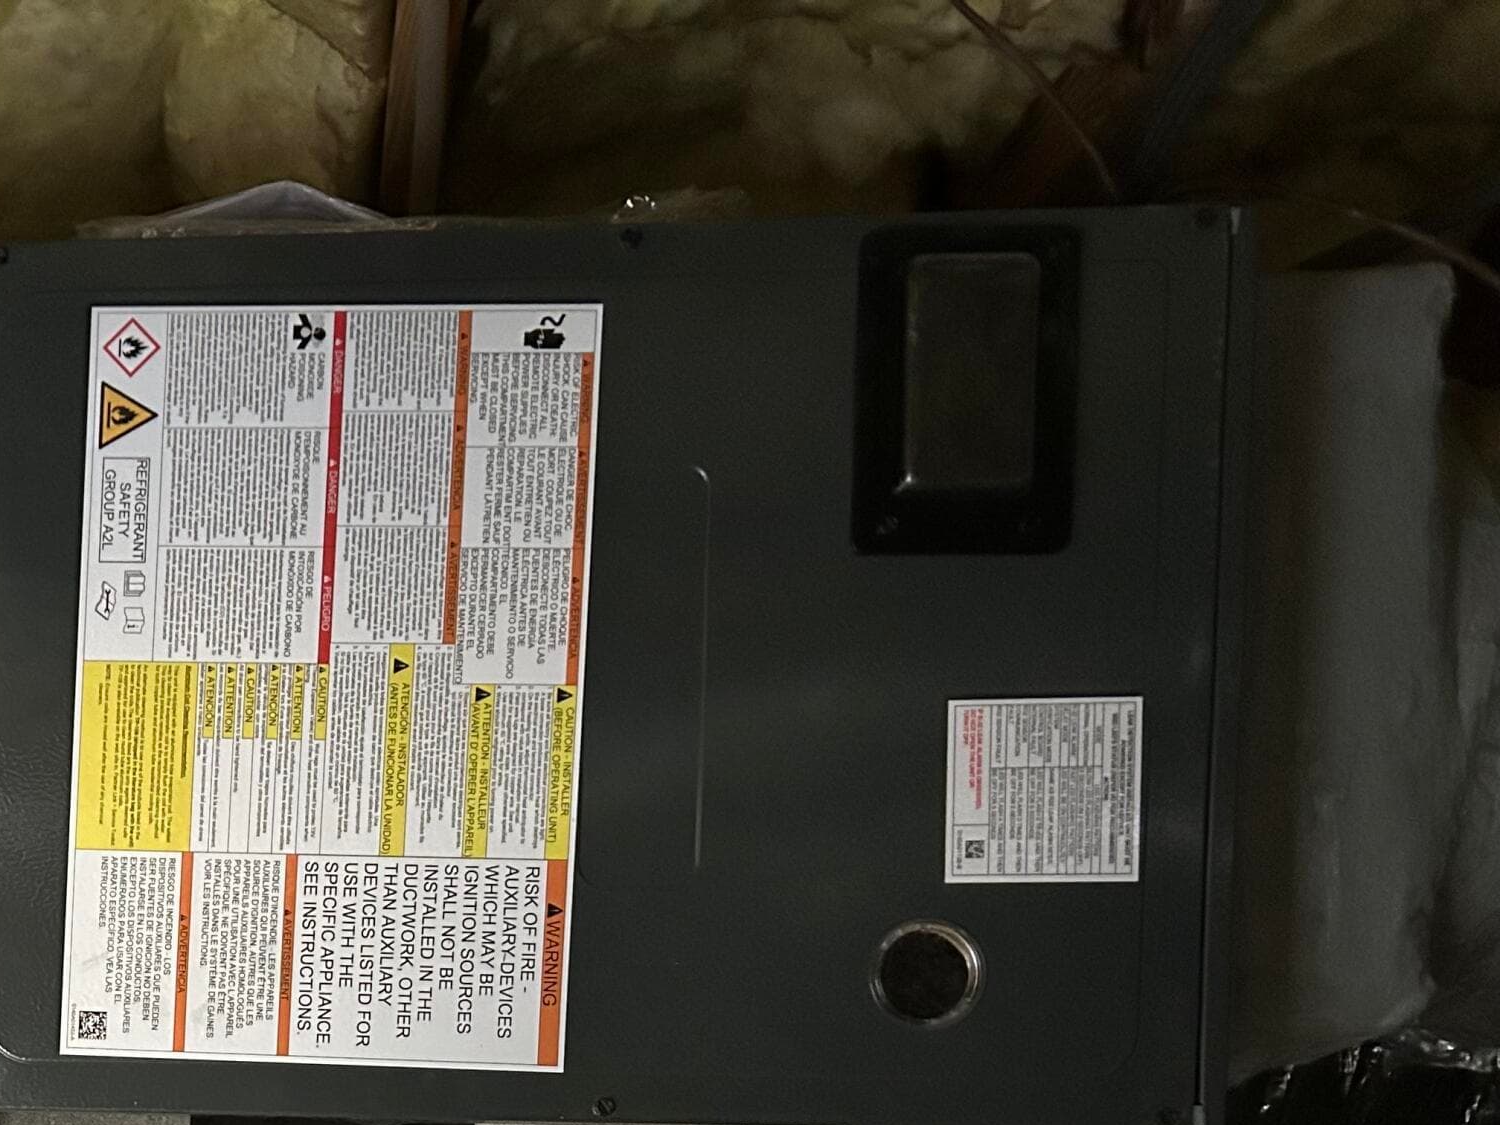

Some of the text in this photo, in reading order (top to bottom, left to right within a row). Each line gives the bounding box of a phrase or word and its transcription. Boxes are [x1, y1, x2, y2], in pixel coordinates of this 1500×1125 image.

[332, 350, 342, 393] DANGER
[102, 469, 116, 550] GROUP A2L
[118, 482, 130, 537] SAFETY
[132, 459, 146, 560] REFRIGERANT
[327, 470, 336, 513] DANGER
[321, 586, 331, 631] PELIGRO
[558, 548, 570, 645] PELIGRO DE CHOQUE
[204, 676, 216, 727] ATENCIÓN
[224, 676, 234, 732] ATTENTION
[244, 678, 254, 722] CAUTION
[268, 675, 279, 726] ATENCIÓN
[292, 676, 302, 733] ATTENTION
[316, 677, 326, 722] CAUTION
[398, 682, 410, 733] ATENCIÓN
[469, 702, 479, 739] (AVANT
[480, 702, 491, 760] ATTENTION
[563, 707, 573, 752] CAUTION
[381, 682, 397, 854] (ANTES DE FUNCIONAR LA UNIDAD)
[395, 743, 406, 806] INSTALADOR
[466, 755, 477, 794] OPERER
[546, 707, 562, 842] (BEFORE OPERATING UNIT)
[560, 761, 571, 815] INSTALLER
[477, 768, 488, 829] INSTALLEUR
[166, 857, 175, 891] RIESGO
[166, 893, 173, 905] DE
[271, 860, 279, 893] RISQUE
[524, 866, 539, 906] RISK
[164, 908, 173, 950] INCENDIO
[268, 896, 278, 945] D'INCENDIE
[296, 861, 318, 1035] SEE INSTRUCTIONS.
[338, 862, 358, 987] USE WITH THE
[377, 863, 397, 1006] THAN AUXILIARY
[417, 864, 438, 1021] INSTALLED IN THE
[438, 864, 458, 990] SHALL NOT BE
[478, 865, 498, 996] WHICH MAY BE
[522, 912, 537, 936] OF
[163, 958, 171, 975] LOS
[177, 925, 187, 992] ADVERTENCIA
[267, 953, 275, 969] LES
[280, 918, 291, 1000] AVERTISSEMENT
[315, 861, 338, 1048] SPECIFIC APPLIANCE.
[356, 862, 377, 1046] DEVICES LISTED FOR
[396, 863, 418, 1038] DUCTWORK, OTHER
[456, 865, 478, 1033] IGNITION SOURCES
[497, 865, 518, 1038] AUXILIARY DEVICES
[520, 942, 535, 981] FIRE
[542, 920, 560, 1006] WARNING
[265, 971, 274, 1020] APPAREILS
